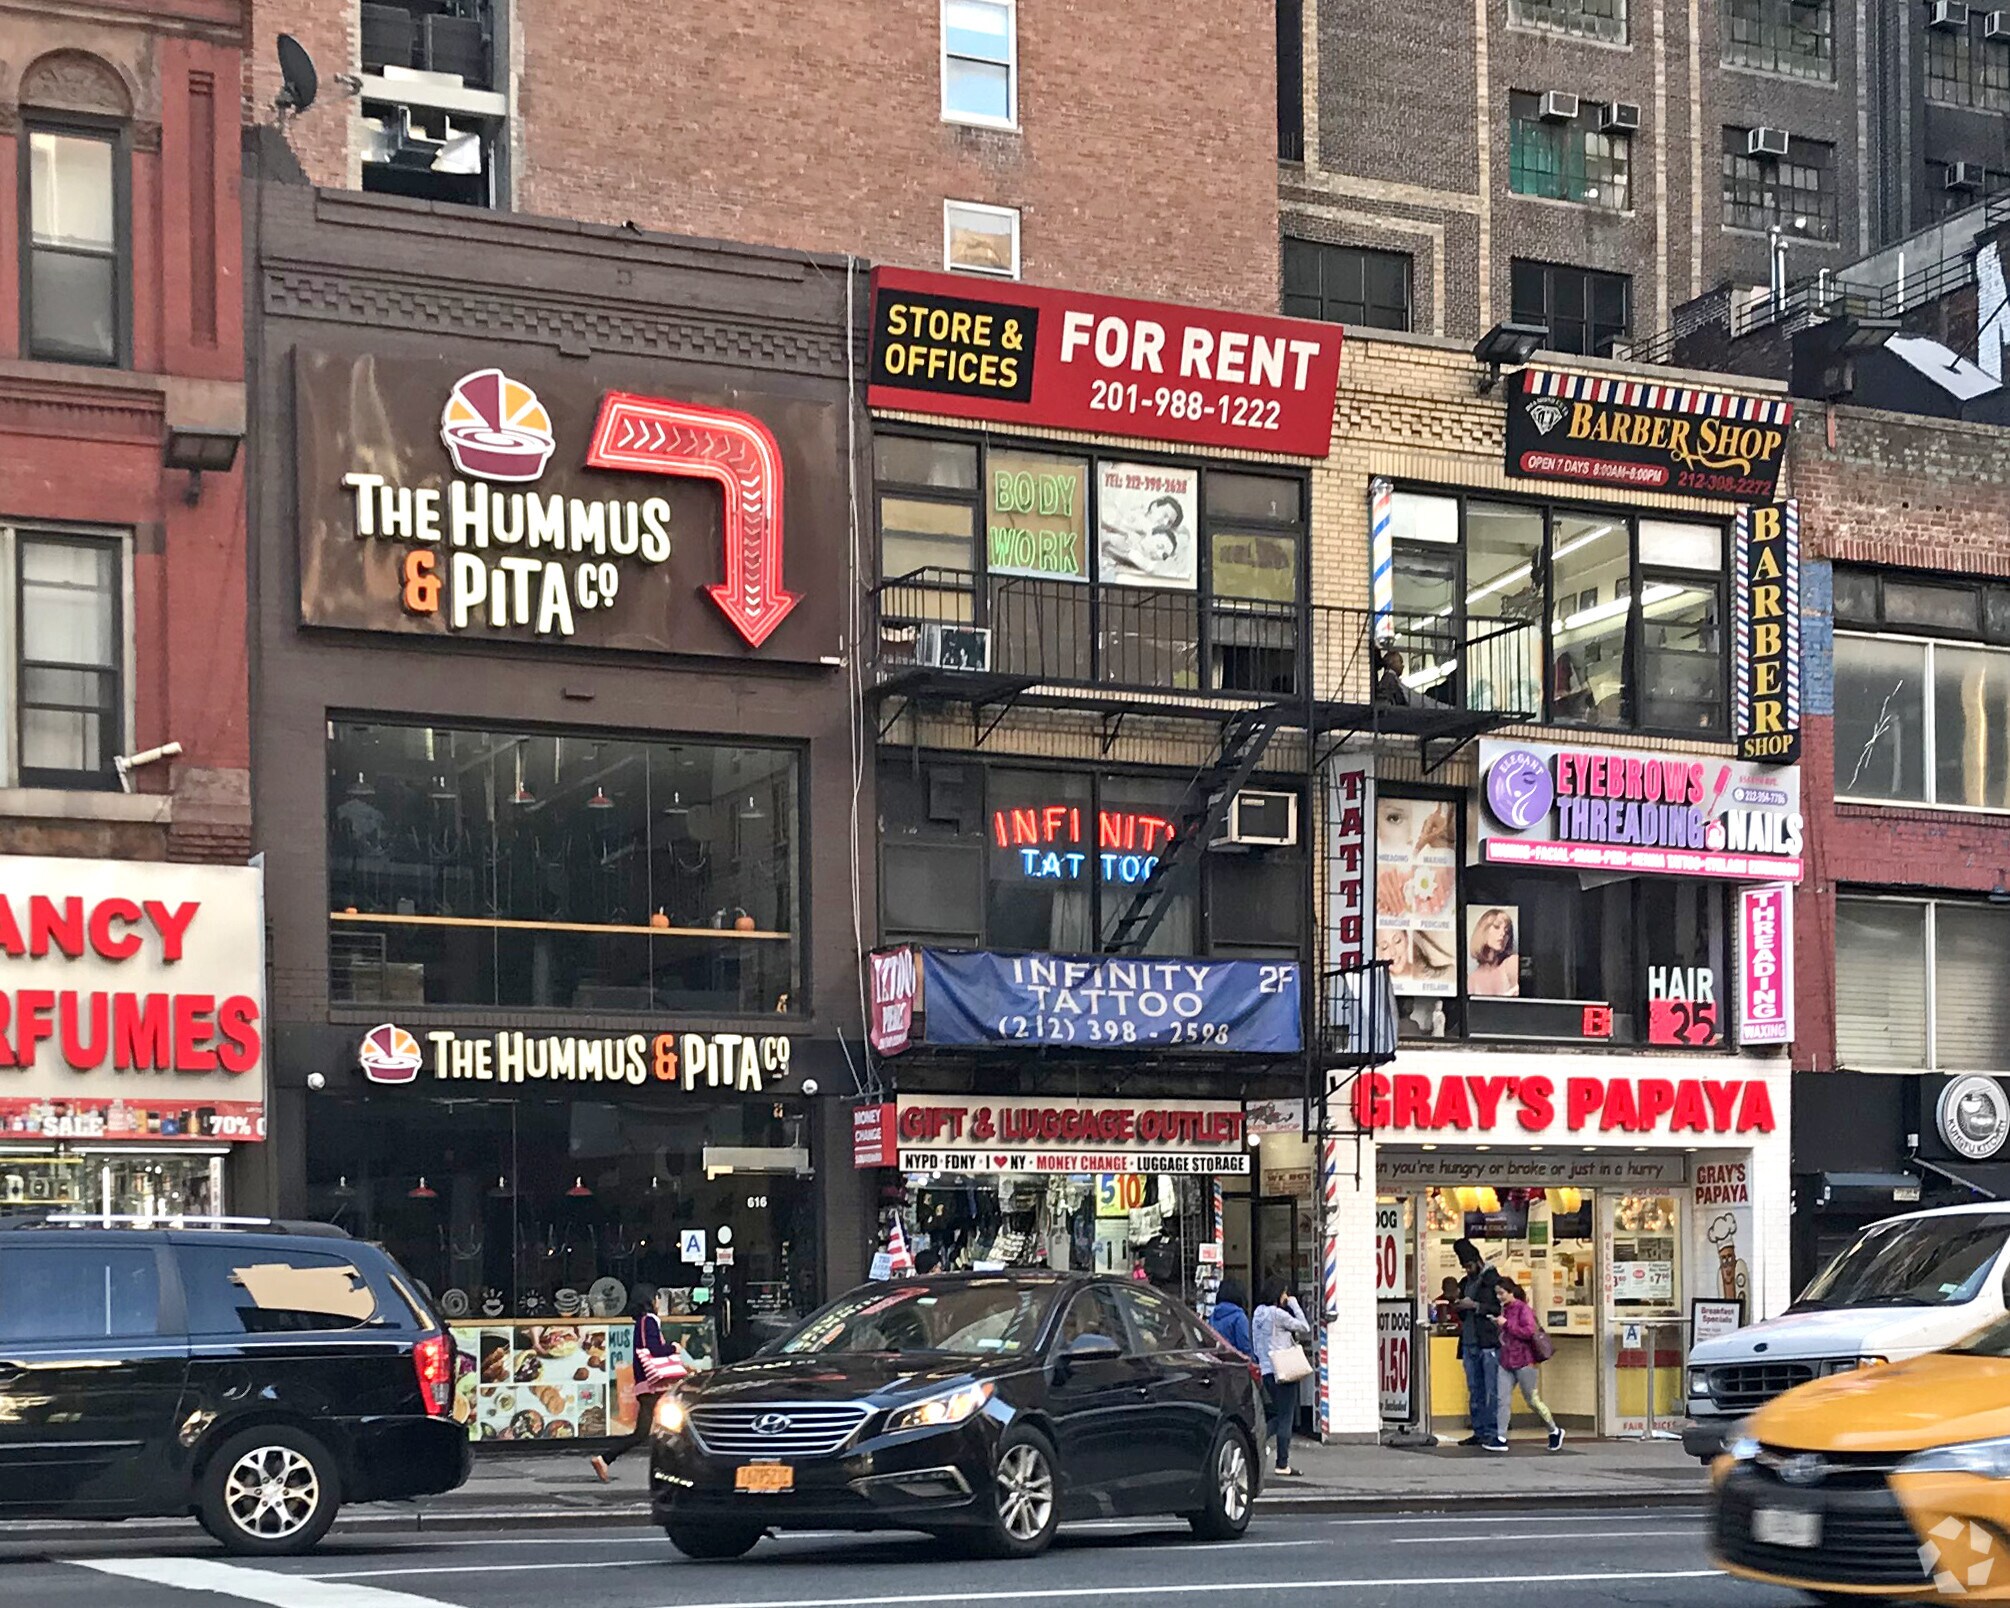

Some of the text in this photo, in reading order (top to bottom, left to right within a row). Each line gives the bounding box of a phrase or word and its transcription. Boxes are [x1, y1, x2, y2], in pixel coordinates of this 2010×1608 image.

[887, 304, 1024, 351] STORE &
[885, 343, 1018, 388] OFFICES
[1060, 311, 1320, 391] FOR RENT
[1090, 380, 1282, 430] 201-988-1222
[1567, 402, 1690, 453] BARBER
[1699, 418, 1782, 462] SHOP
[1527, 454, 1556, 471] OPEN
[1556, 457, 1564, 471] 7
[1564, 459, 1590, 475] DAYS
[994, 470, 1076, 517] BODY
[343, 473, 672, 564] THE HUMMUS
[989, 525, 1079, 575] WORK
[404, 550, 442, 613] &
[451, 551, 575, 636] PITA
[1752, 507, 1785, 735] BARBER
[1498, 753, 1545, 776] ELEGANT
[1744, 734, 1794, 759] SHOP
[1556, 753, 1706, 805] EYEBROWS
[1556, 797, 1705, 850] THREADING
[1728, 809, 1804, 854] NAILS
[1338, 769, 1365, 971] TATTOO
[1752, 891, 1777, 1019] THREADING
[1012, 958, 1294, 994] INFINITY 2F
[1648, 965, 1715, 1004] HAIR
[1027, 984, 1204, 1019] TATTOO
[998, 1014, 1076, 1043] (212)
[1086, 1018, 1137, 1044] 398
[1169, 1020, 1230, 1046] 2598
[1671, 1002, 1715, 1044] 25
[1743, 1023, 1786, 1041] WAXING
[428, 1031, 492, 1079] THE
[497, 1031, 647, 1085] HUMMUS
[653, 1033, 678, 1081] &
[681, 1032, 763, 1091] PITA
[854, 1109, 881, 1125] MONEY
[1350, 1072, 1776, 1134] GRAY'S PAPAYA
[42, 1115, 105, 1137] SALE
[209, 1115, 252, 1136] 70%
[854, 1127, 882, 1142] CHANGE
[902, 1106, 1246, 1142] GIFT & LUGGAGE OUTLET
[905, 1153, 1245, 1172] NYPD FDNY I NY MONEY CHANGE LUGGAGE STORAGE
[1392, 1159, 1436, 1180] you're
[1439, 1159, 1485, 1182] hungry
[1489, 1164, 1503, 1175] or
[1507, 1160, 1546, 1176] broke
[1551, 1163, 1565, 1176] or
[1568, 1161, 1596, 1180] just
[1599, 1161, 1611, 1176] in
[1615, 1164, 1623, 1176] a
[1627, 1160, 1664, 1181] hurry
[1696, 1163, 1746, 1185] GRAY'S
[746, 1196, 768, 1209] 616
[1101, 1173, 1141, 1210] 5 10
[1696, 1183, 1749, 1205] PAPAYA
[685, 1234, 701, 1253] A
[1391, 1312, 1411, 1332] DOG
[1701, 1306, 1735, 1316] Breakfast
[1702, 1315, 1733, 1325] Specials
[1626, 1325, 1638, 1341] A
[1380, 1336, 1409, 1394] 1.50
[1623, 1420, 1677, 1431] FAIR RICES
